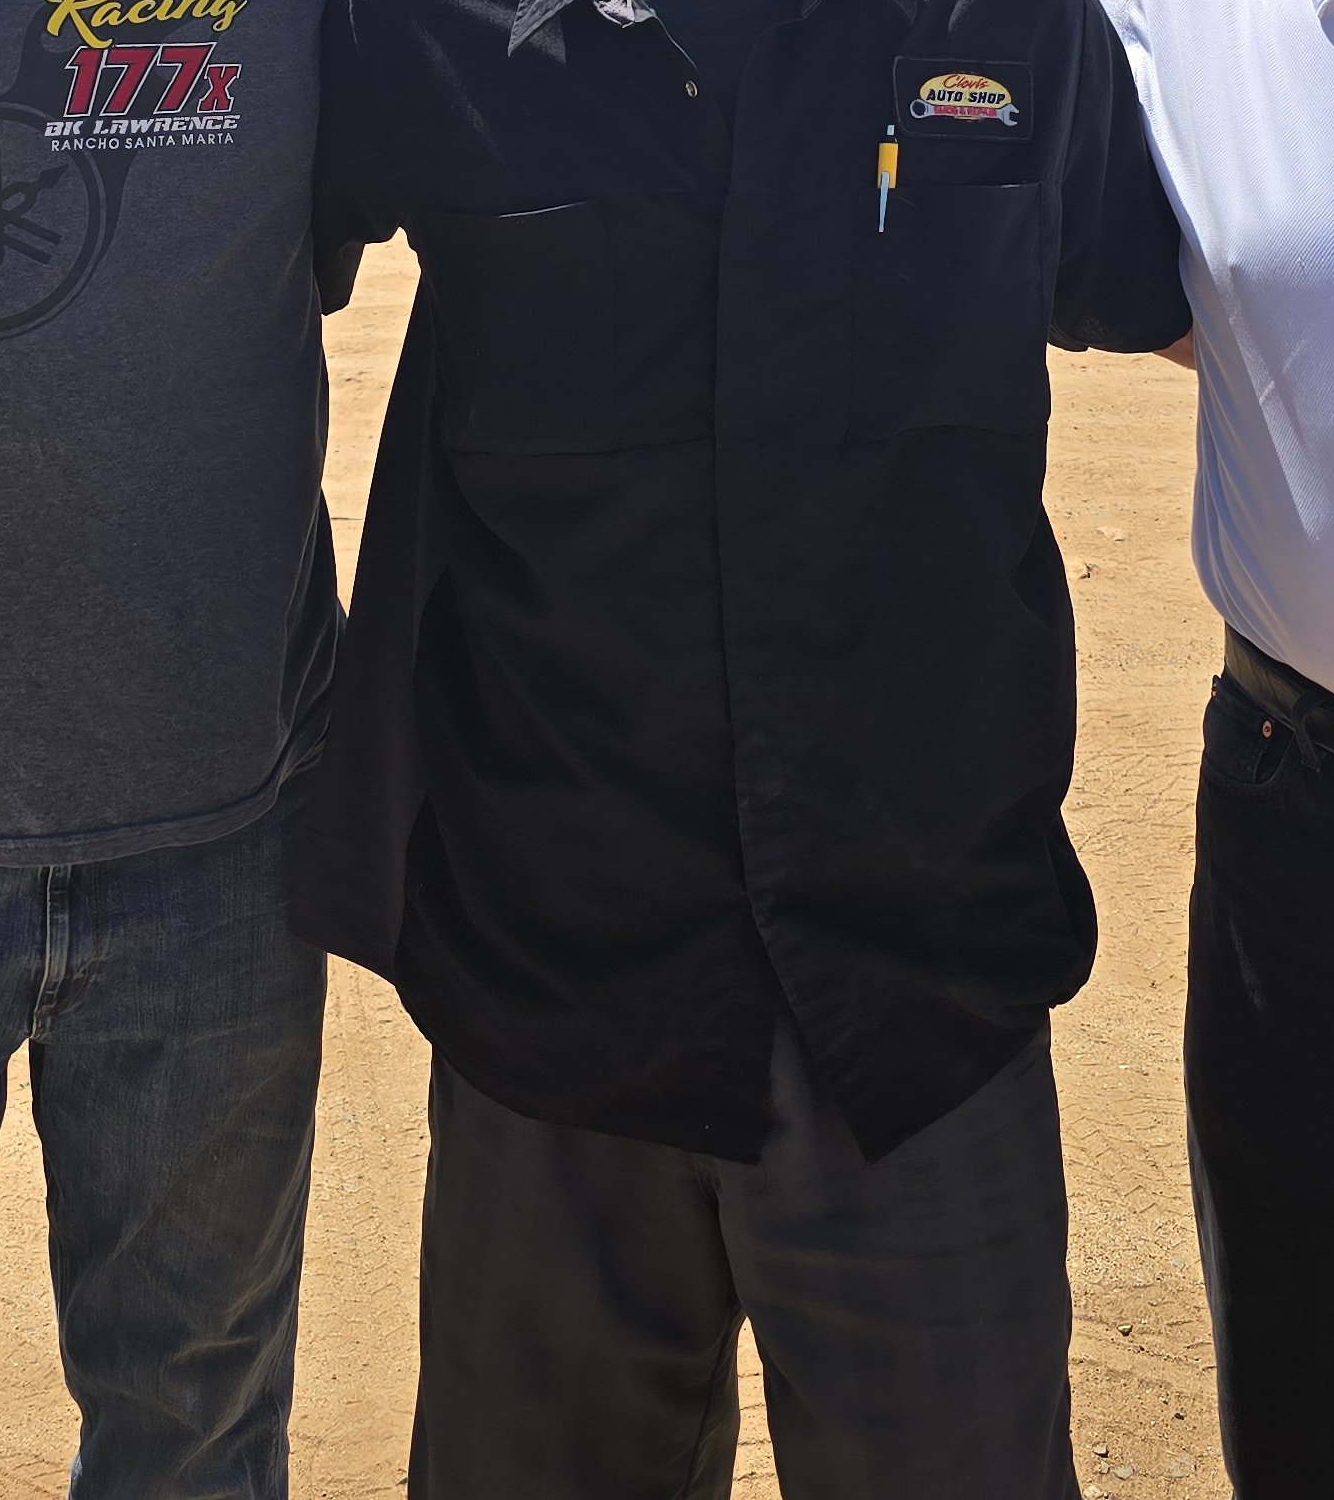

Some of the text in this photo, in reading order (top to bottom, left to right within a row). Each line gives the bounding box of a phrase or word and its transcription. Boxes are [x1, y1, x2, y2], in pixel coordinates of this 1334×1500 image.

[926, 88, 1006, 105] AUTO SHOP
[93, 115, 240, 135] LAWRENCE
[51, 133, 234, 151] RANCHO SANTA MARTA
